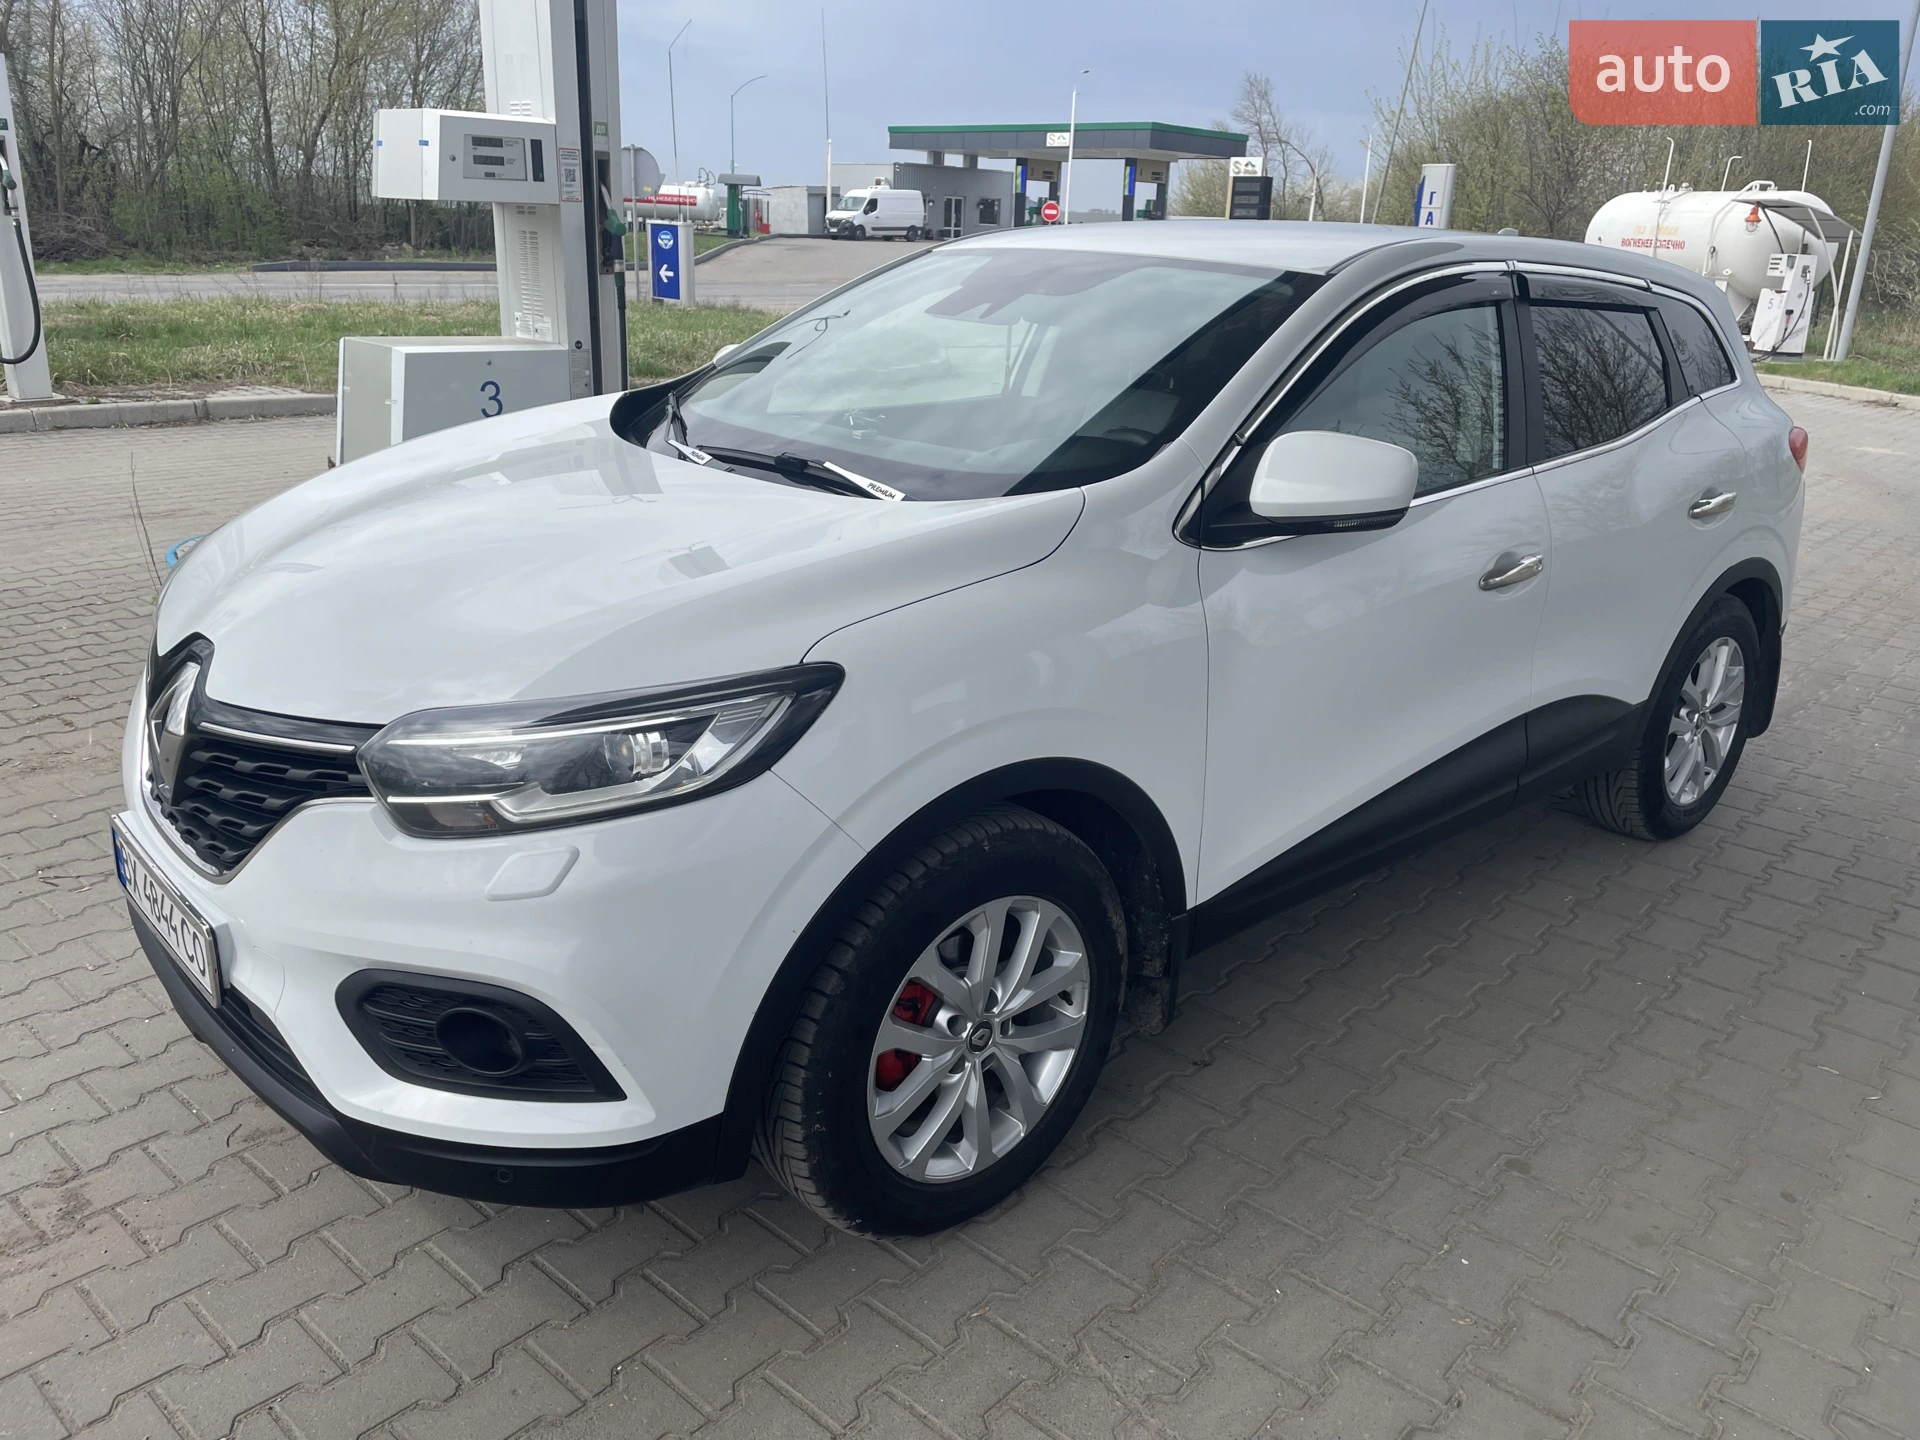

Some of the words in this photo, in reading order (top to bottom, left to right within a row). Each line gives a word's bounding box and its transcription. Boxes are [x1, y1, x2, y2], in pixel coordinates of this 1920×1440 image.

[1768, 298, 1774, 310] 5
[480, 380, 503, 418] 3
[867, 482, 896, 500] PREMIUM
[143, 872, 180, 949] 4844
[180, 916, 206, 978] CO
